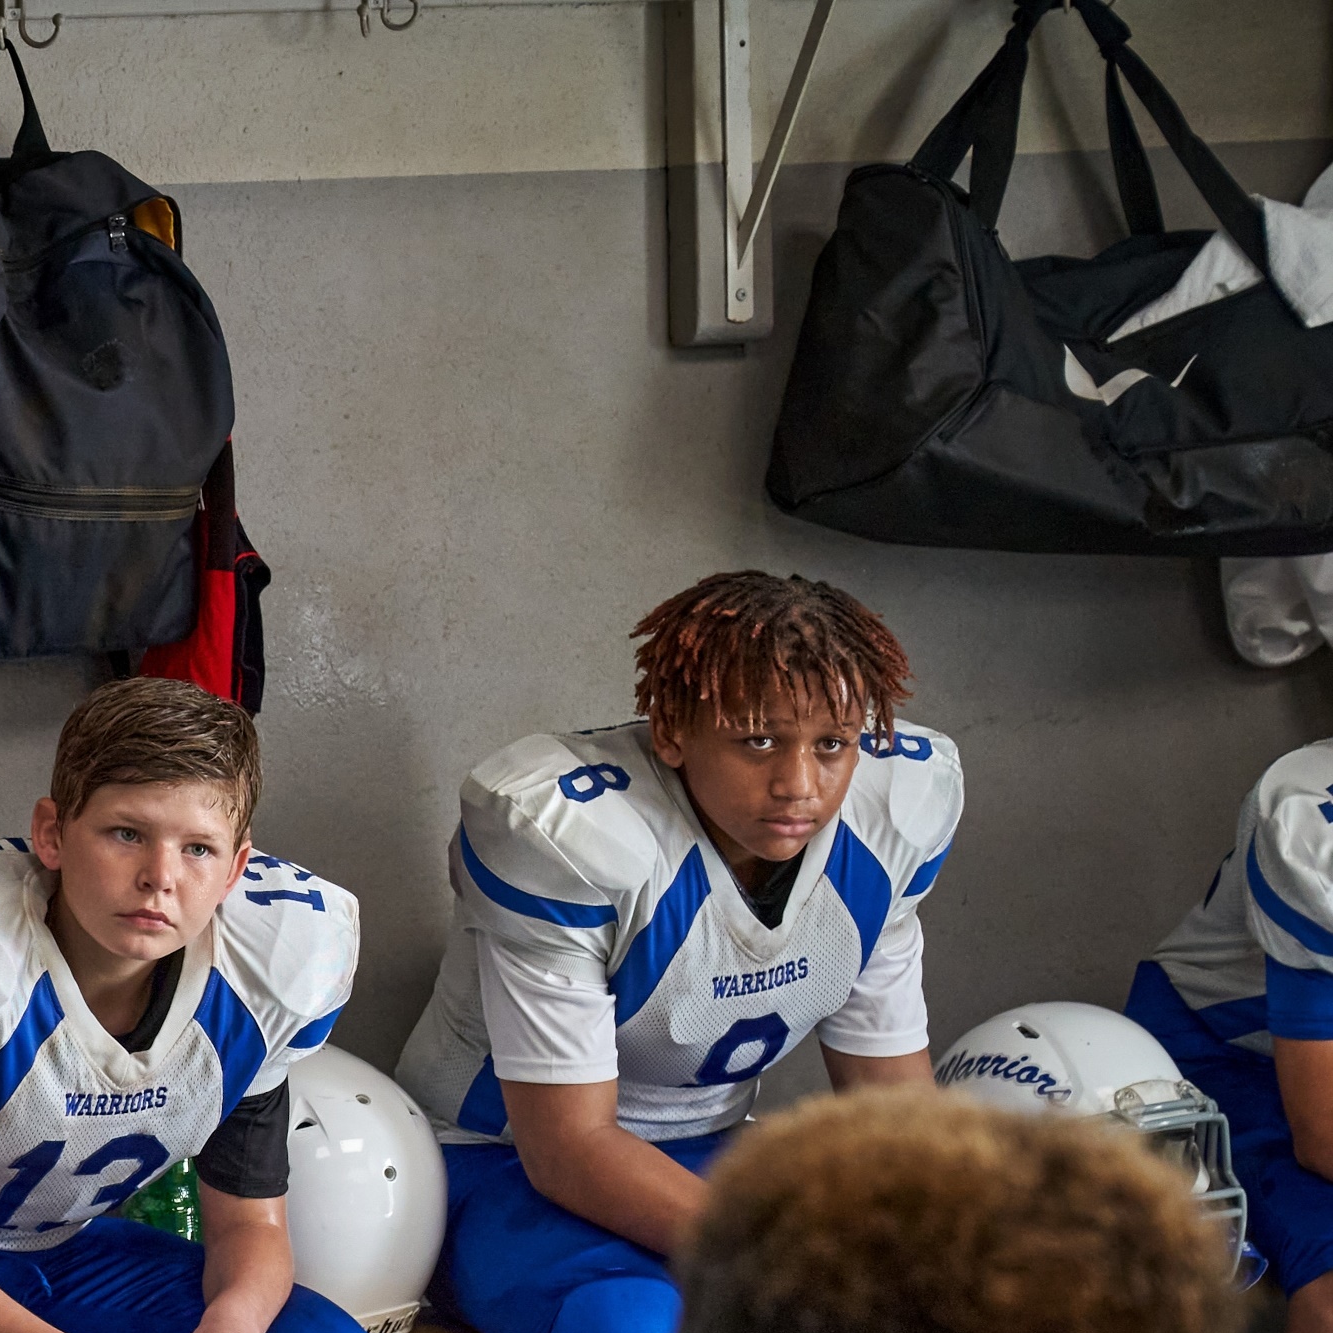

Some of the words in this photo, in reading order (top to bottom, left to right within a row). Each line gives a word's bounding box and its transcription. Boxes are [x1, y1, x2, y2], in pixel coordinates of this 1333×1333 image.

[859, 730, 933, 761] 8
[558, 763, 631, 803] 8
[712, 957, 809, 999] WARRIORS
[65, 1086, 168, 1117] WARRIORS
